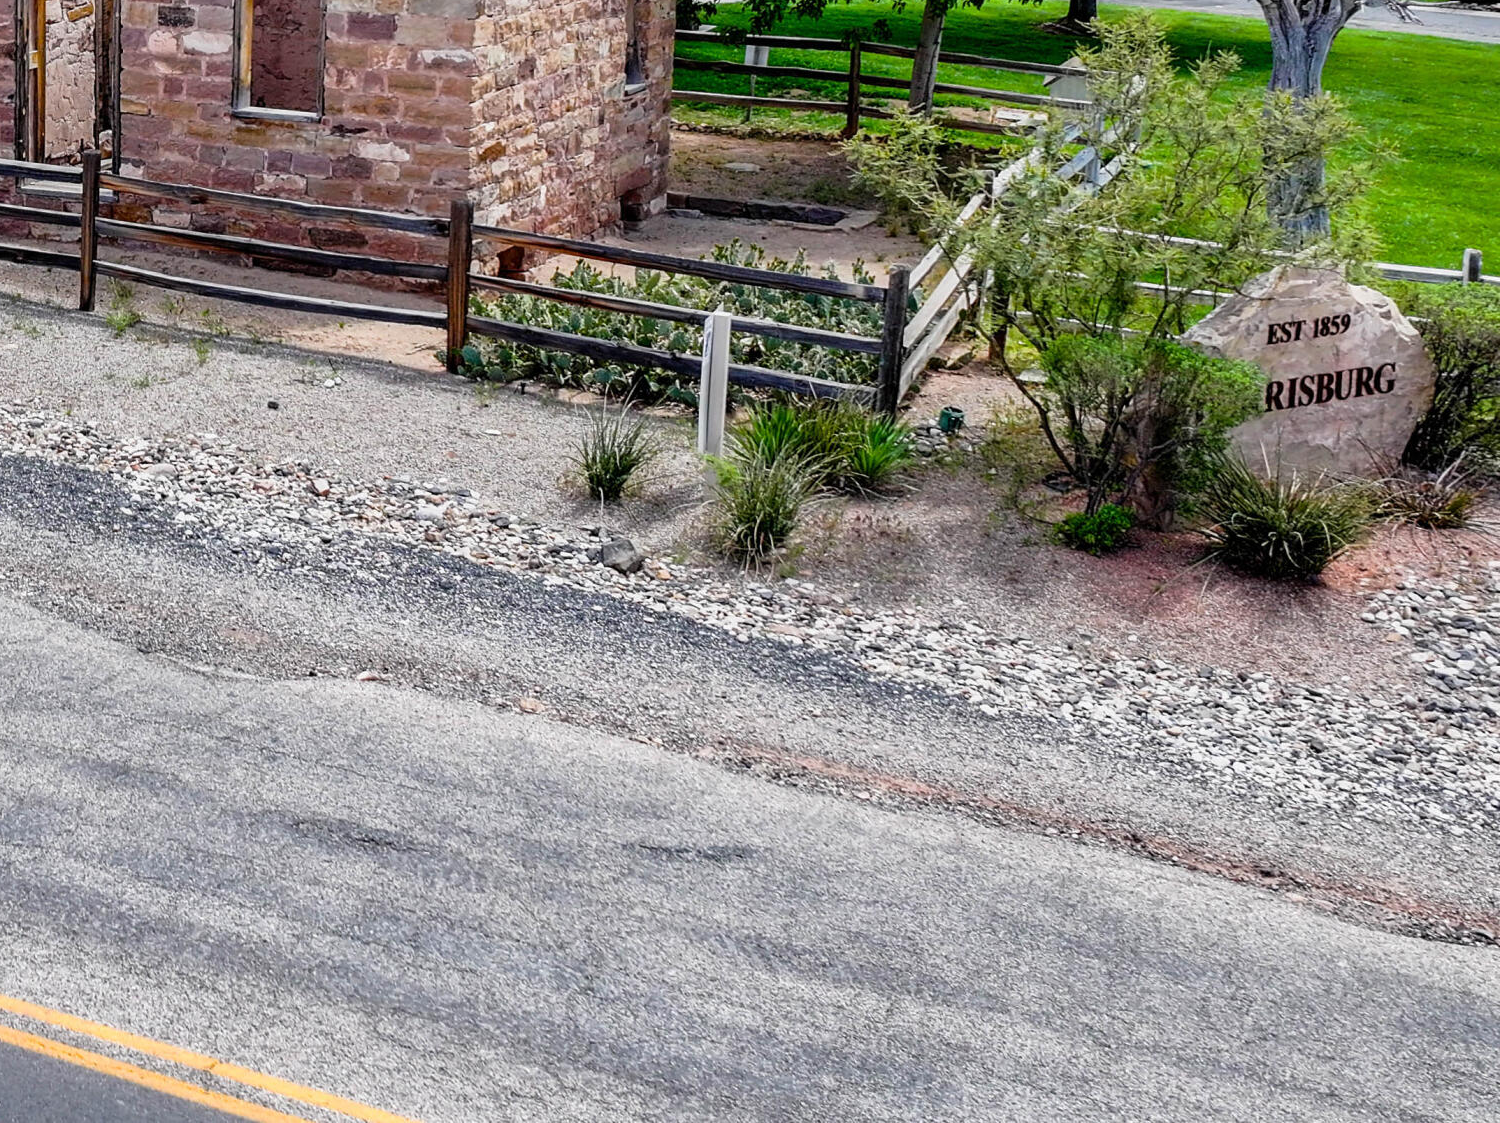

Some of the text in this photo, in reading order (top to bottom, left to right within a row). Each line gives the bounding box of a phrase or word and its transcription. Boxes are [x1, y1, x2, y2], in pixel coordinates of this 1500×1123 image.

[1266, 314, 1351, 345] EST 1859
[1264, 362, 1396, 412] RISBURG
